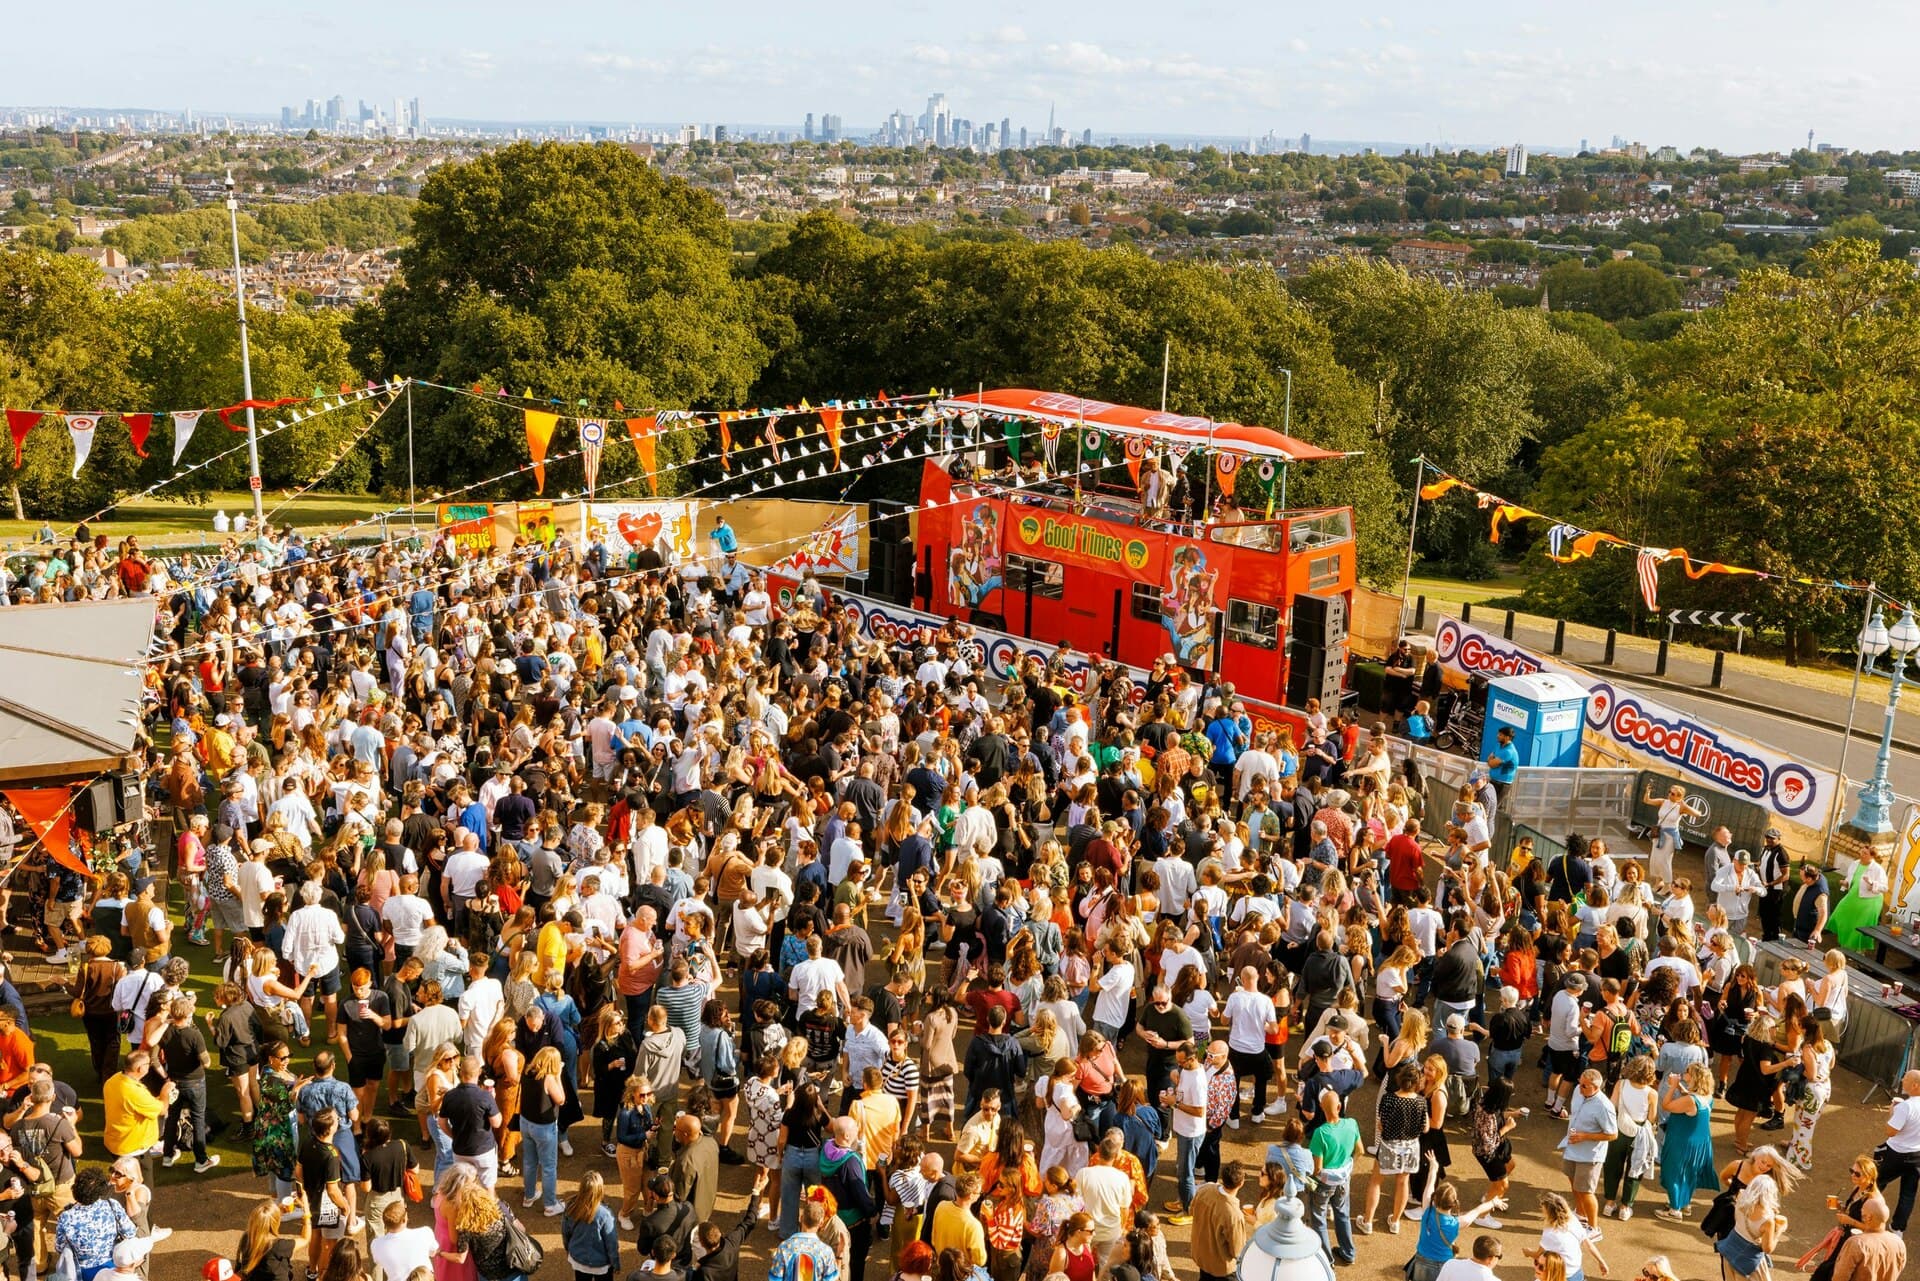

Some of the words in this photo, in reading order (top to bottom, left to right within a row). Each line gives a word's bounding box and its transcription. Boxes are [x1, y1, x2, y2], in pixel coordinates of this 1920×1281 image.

[1044, 518, 1078, 552] Good
[1081, 524, 1123, 562] Times
[1461, 639, 1521, 677] Good
[1614, 705, 1690, 759] Good
[1688, 733, 1764, 791] Times
